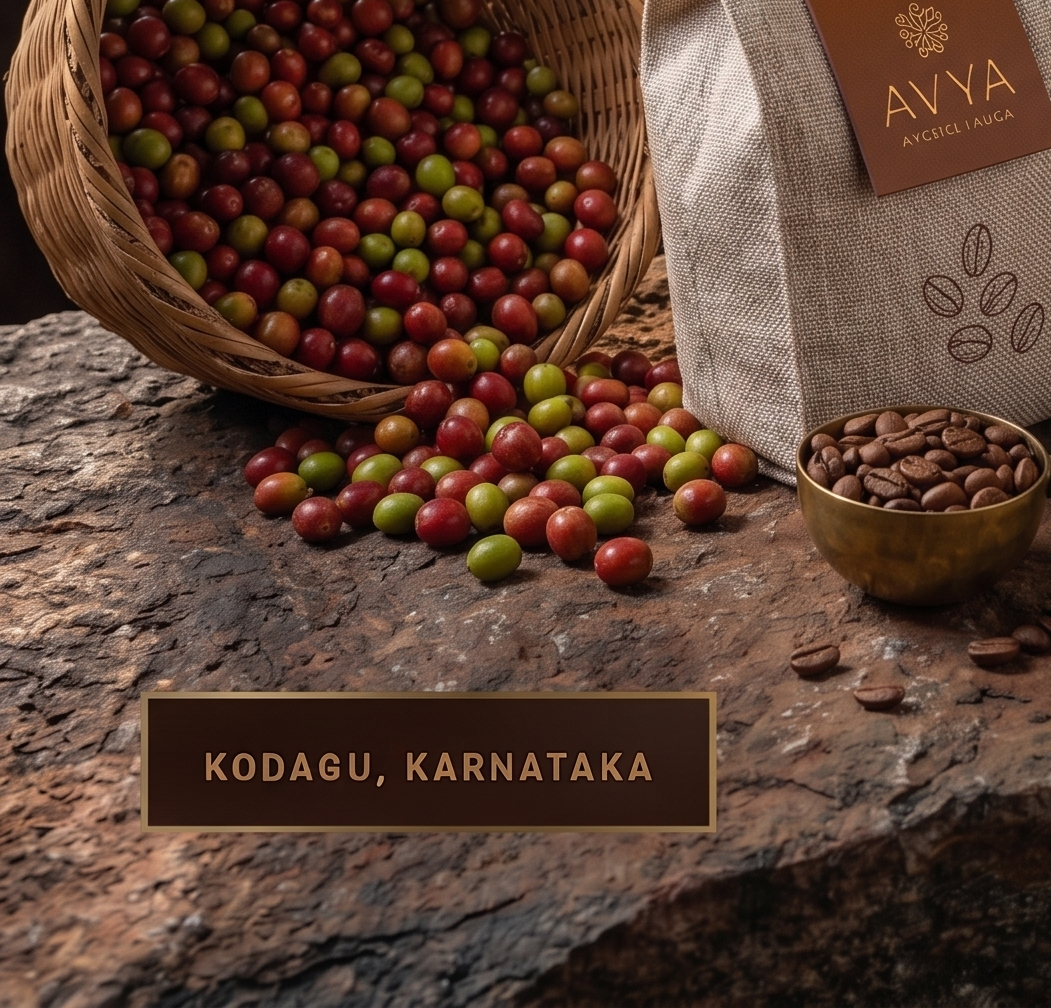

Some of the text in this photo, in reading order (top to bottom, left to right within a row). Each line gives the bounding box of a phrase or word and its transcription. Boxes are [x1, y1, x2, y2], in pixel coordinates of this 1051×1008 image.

[885, 58, 1016, 128] AVYA
[204, 752, 654, 788] KODAGU, KARNATAKA
